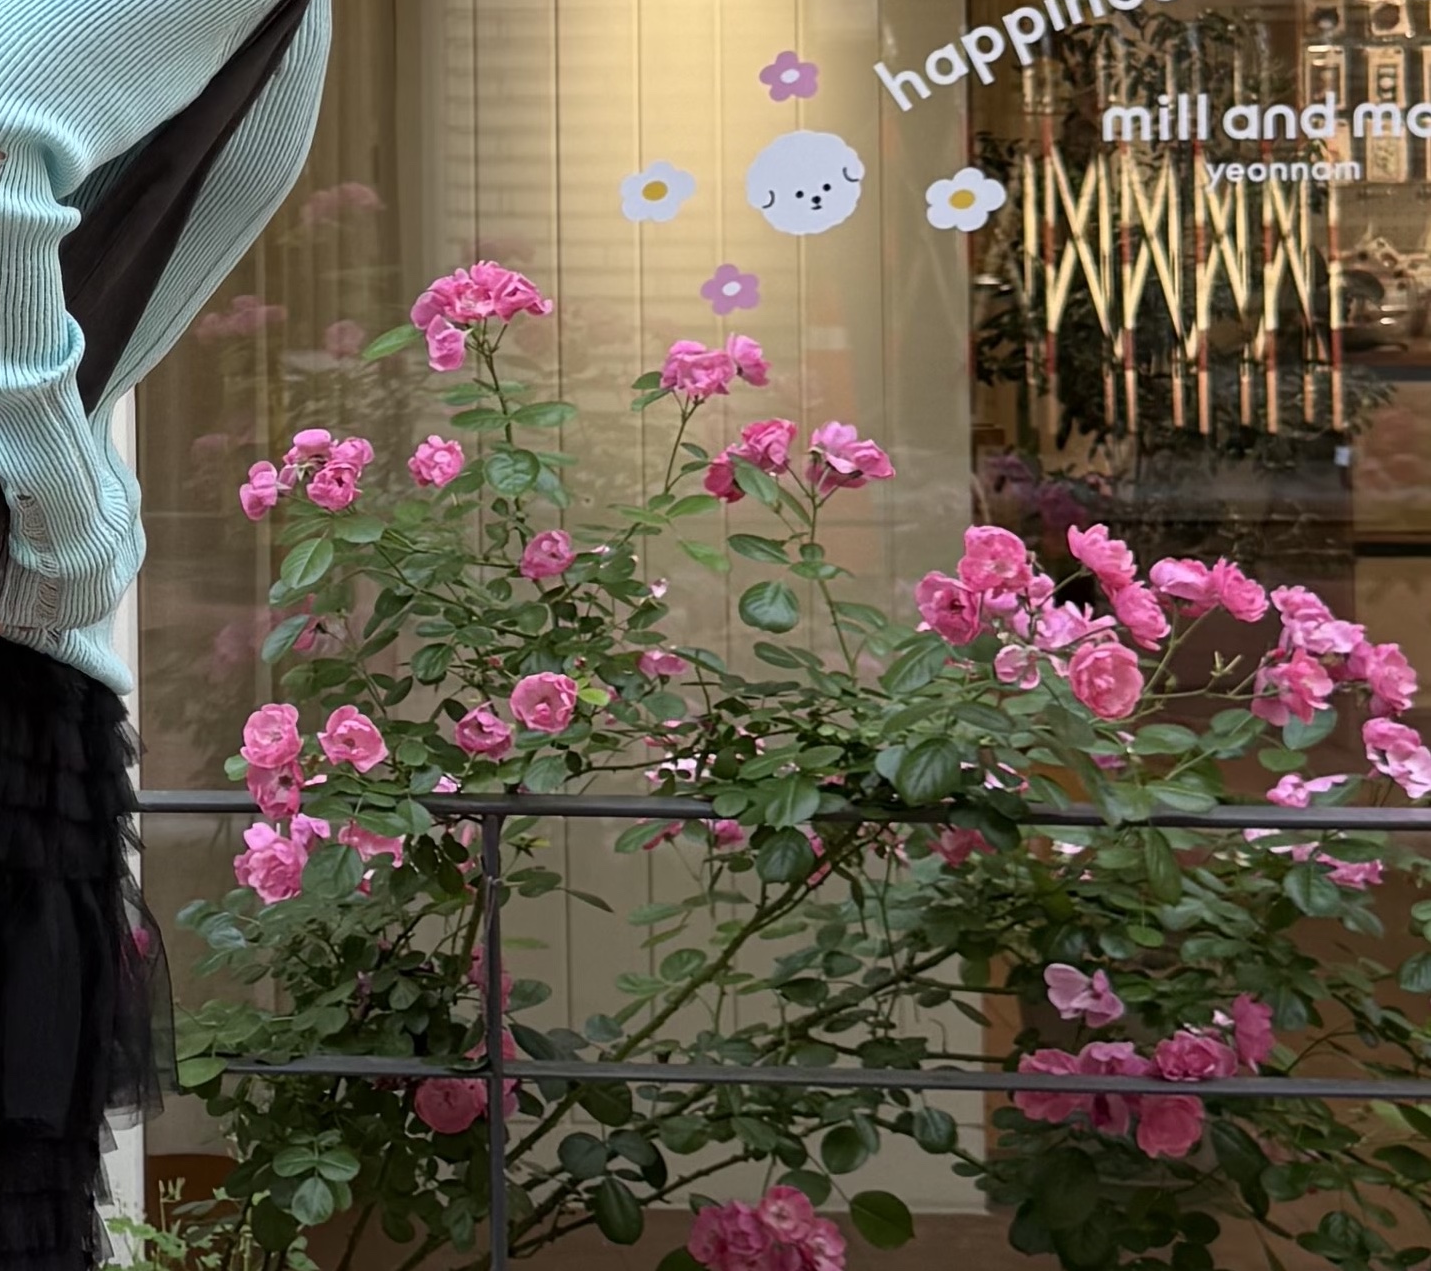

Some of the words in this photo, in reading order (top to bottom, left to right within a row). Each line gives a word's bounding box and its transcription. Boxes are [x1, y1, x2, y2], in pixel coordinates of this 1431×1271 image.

[1102, 93, 1208, 142] mill
[1222, 91, 1337, 140] and
[1206, 160, 1360, 191] yeonnam
